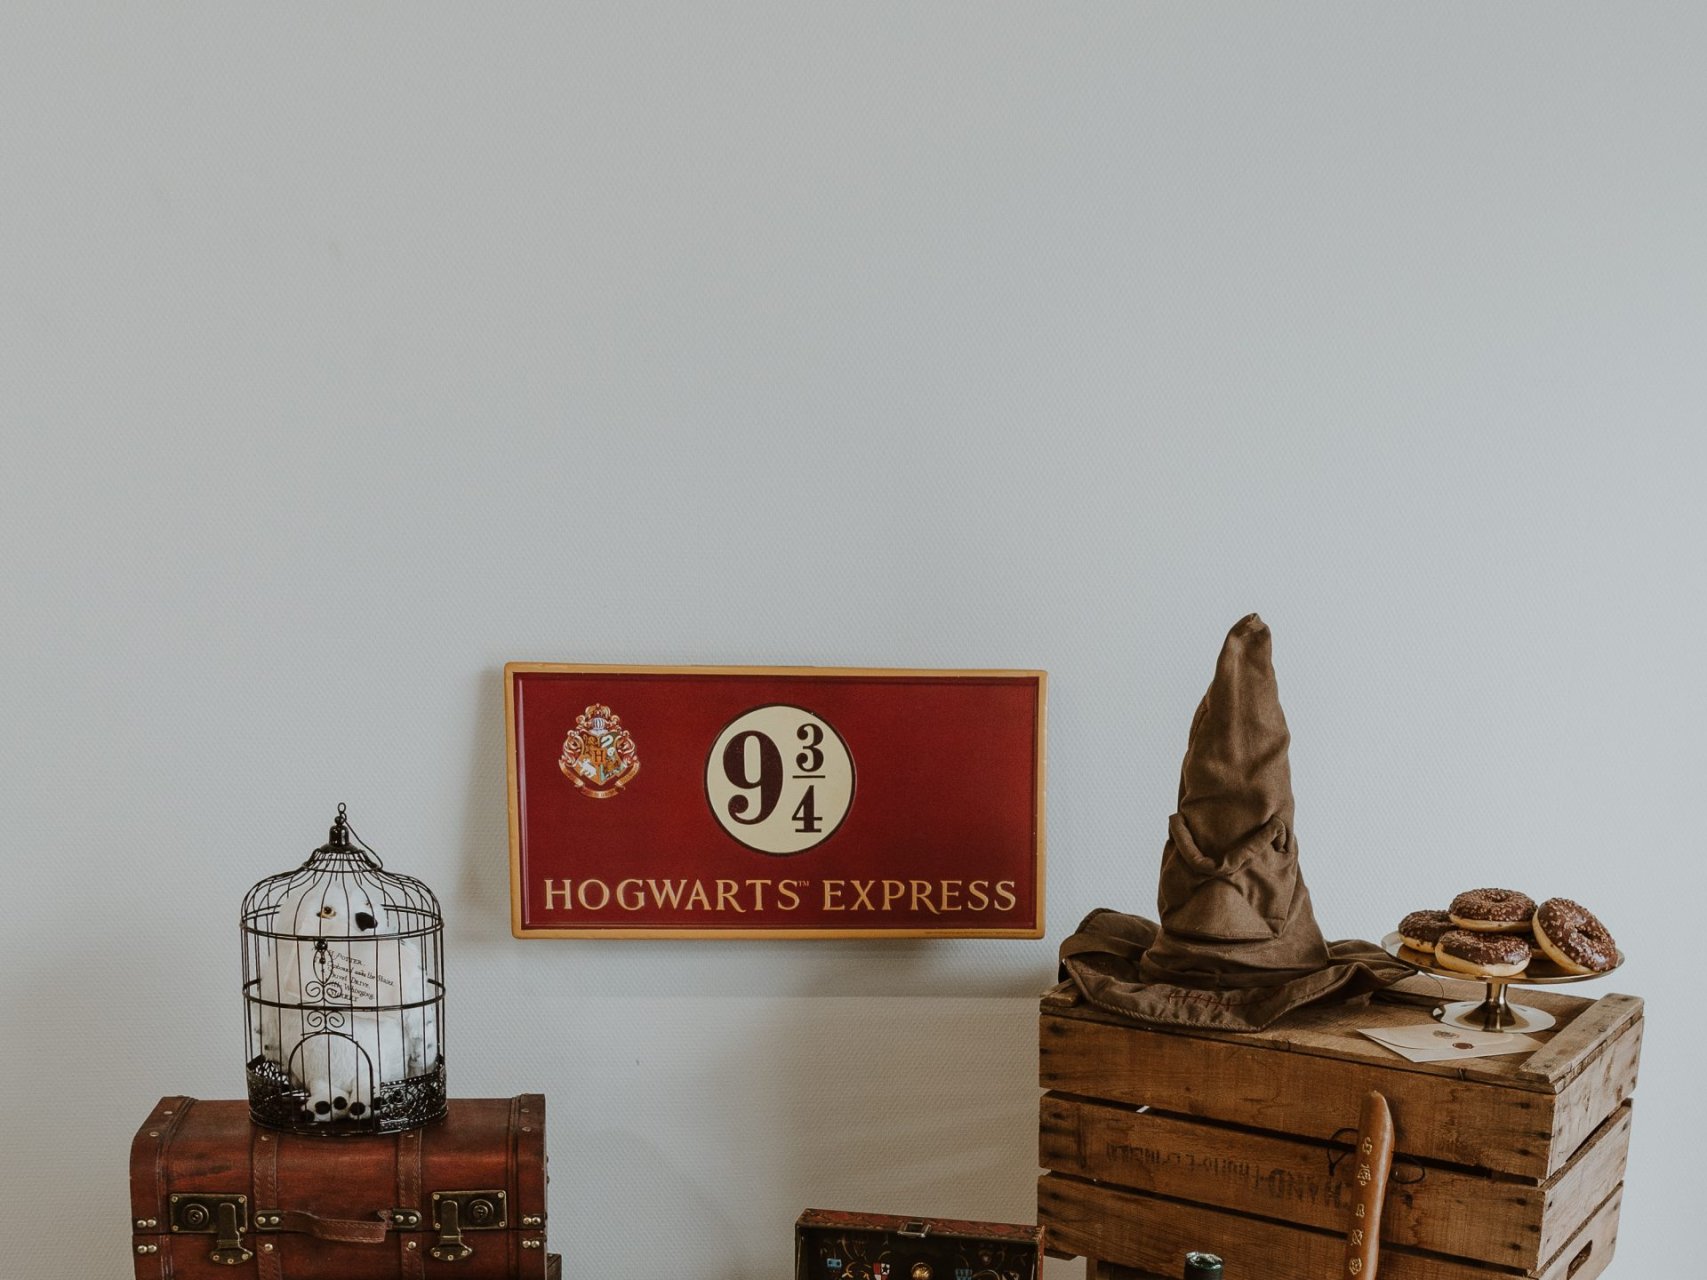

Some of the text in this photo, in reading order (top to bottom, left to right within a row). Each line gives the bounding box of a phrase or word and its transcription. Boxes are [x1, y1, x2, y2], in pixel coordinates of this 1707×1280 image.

[593, 750, 603, 762] H
[722, 729, 784, 825] 9
[822, 879, 1017, 915] EXPRESS
